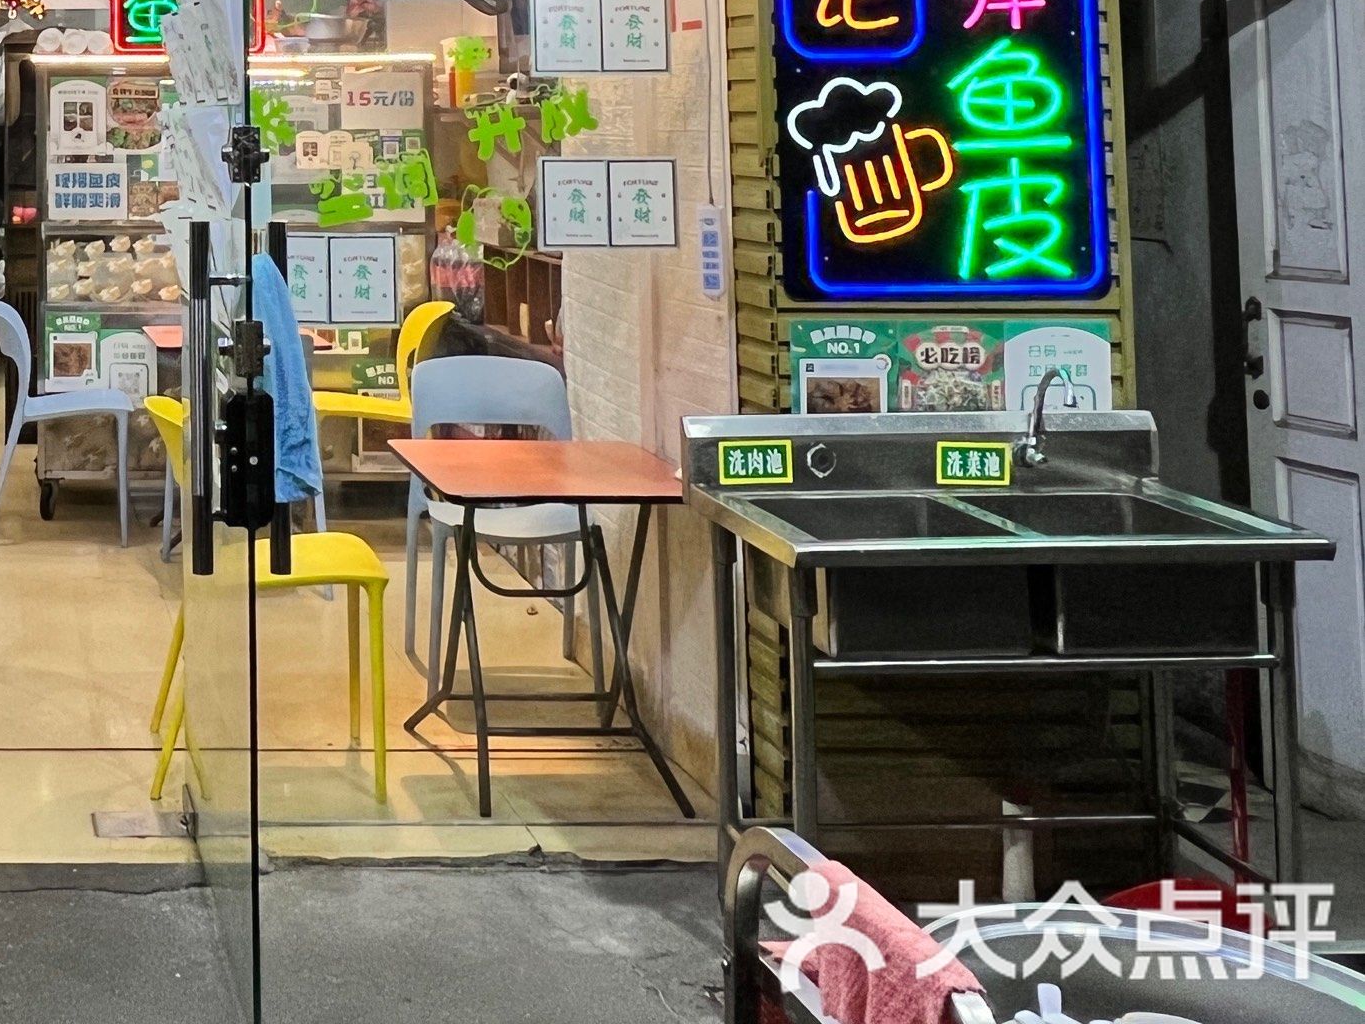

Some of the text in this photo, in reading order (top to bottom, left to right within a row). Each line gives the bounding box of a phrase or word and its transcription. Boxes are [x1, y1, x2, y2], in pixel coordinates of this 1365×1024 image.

[625, 14, 644, 50] 發財
[345, 91, 415, 107] 15元/份
[632, 188, 652, 224] 發財
[352, 264, 373, 301] 發財
[920, 347, 981, 365] 必吃榜
[728, 448, 784, 476] 洗肉池
[946, 450, 1001, 477] 洗菜池
